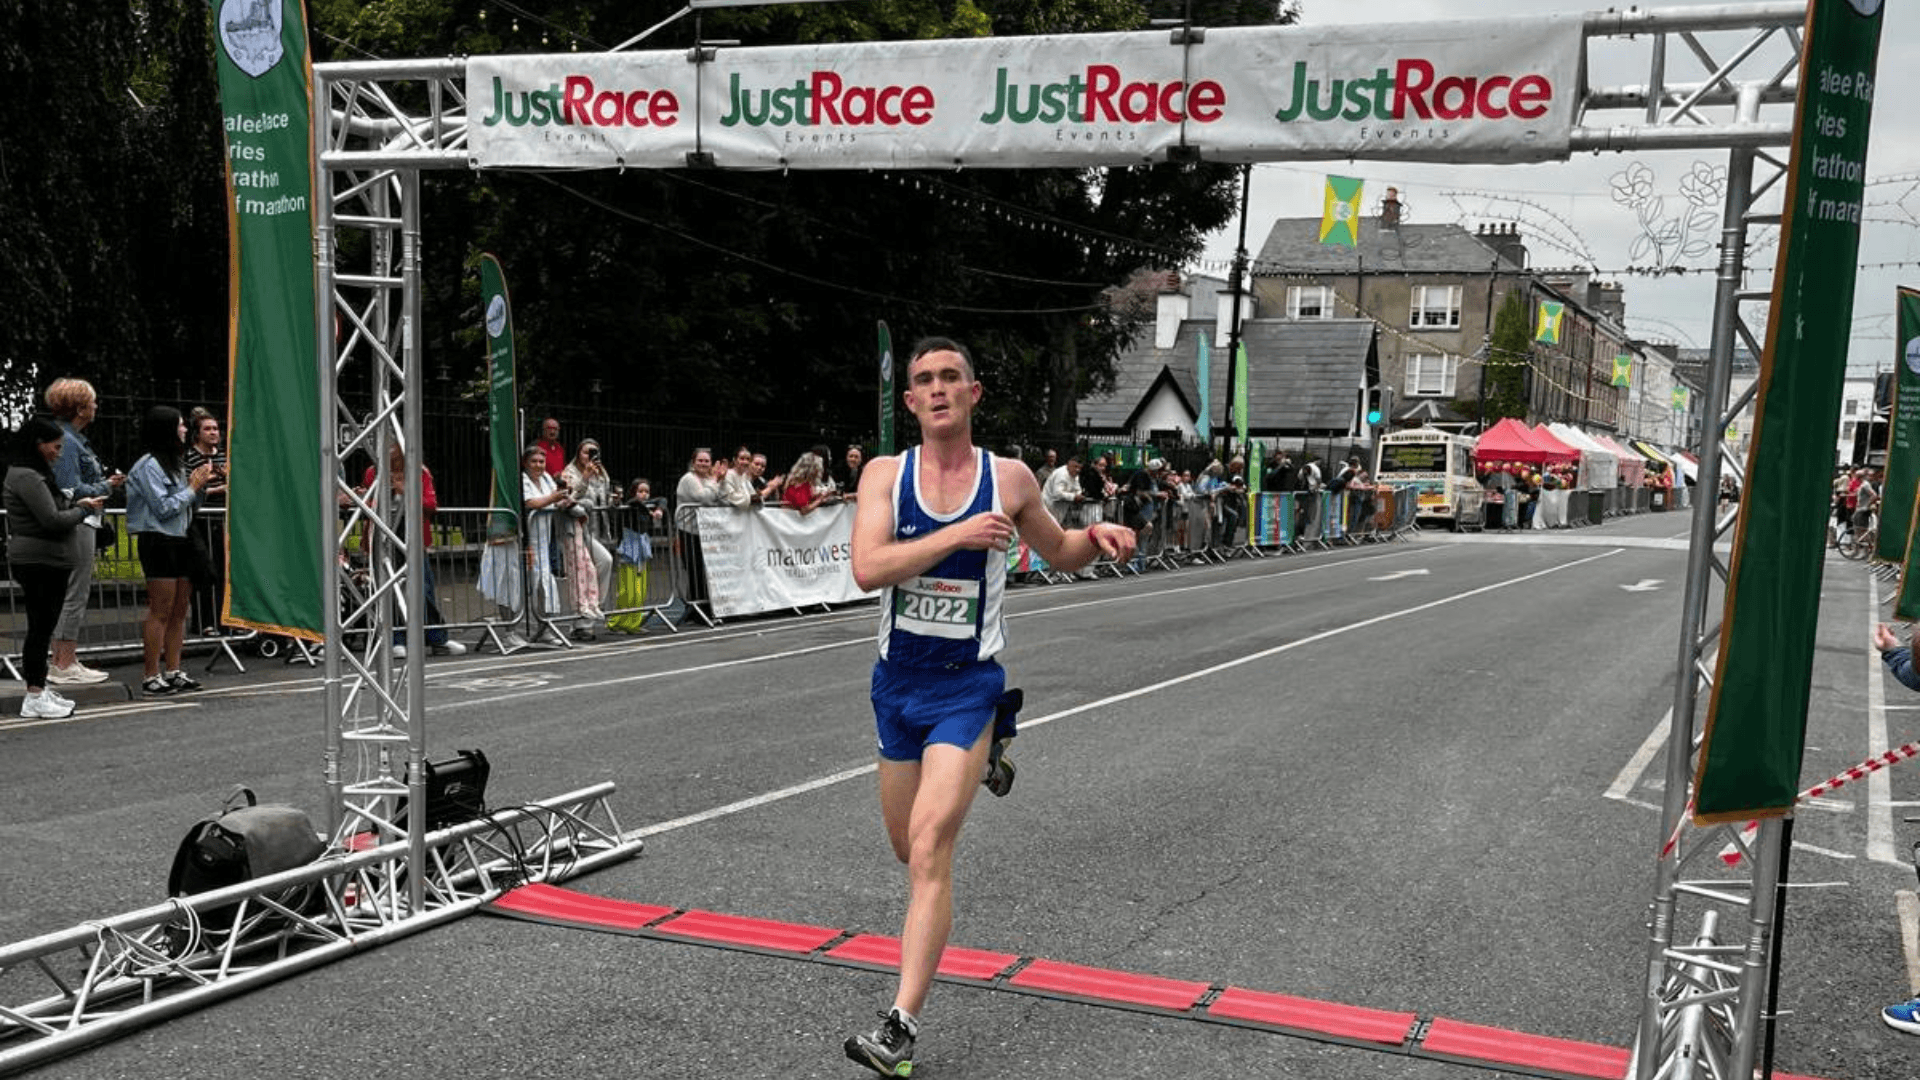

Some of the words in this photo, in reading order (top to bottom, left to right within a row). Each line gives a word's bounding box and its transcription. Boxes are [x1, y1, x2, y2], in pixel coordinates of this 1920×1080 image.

[482, 75, 679, 127] JustRace
[719, 71, 935, 127] JustRace
[980, 64, 1226, 124] JustRace
[1276, 58, 1553, 123] JustRace
[544, 130, 607, 144] Events
[784, 131, 857, 143] Events
[1055, 128, 1137, 142] Events
[1360, 126, 1451, 140] Events
[903, 593, 970, 624] 2022
